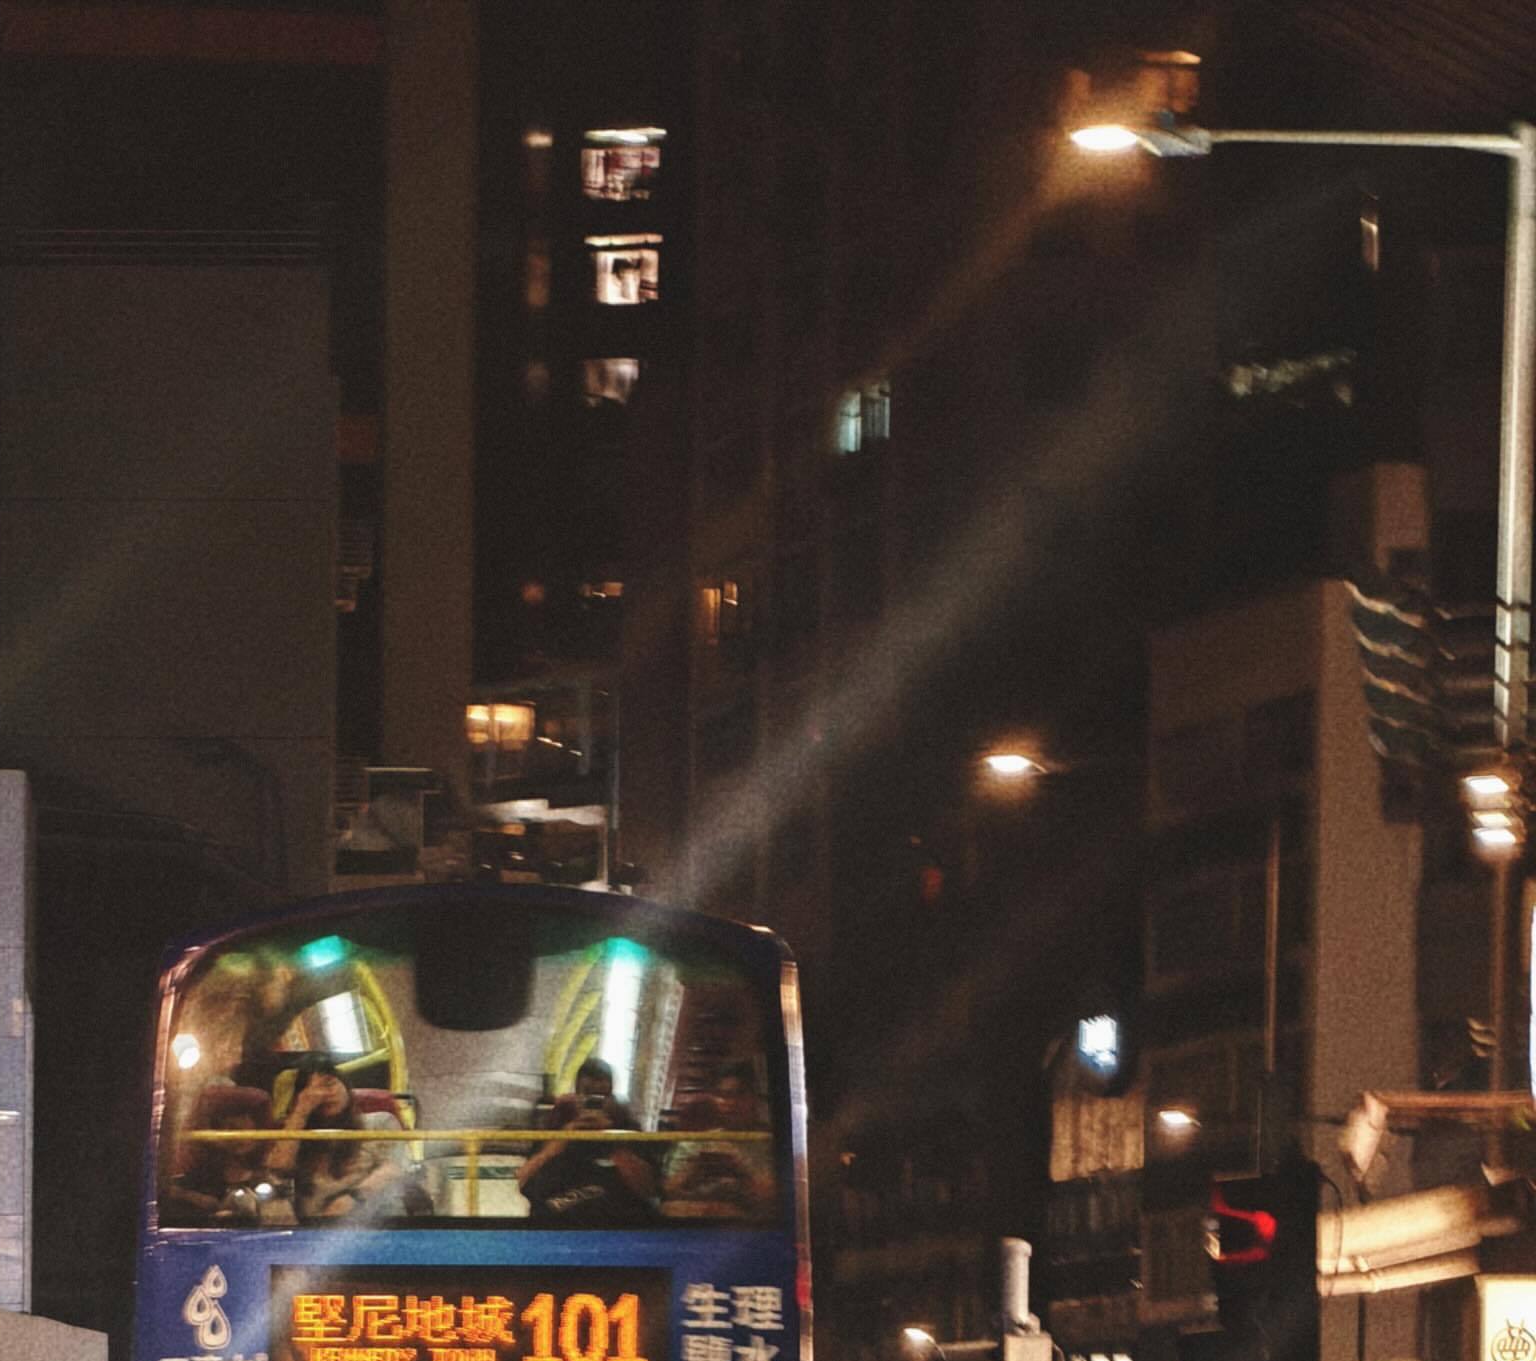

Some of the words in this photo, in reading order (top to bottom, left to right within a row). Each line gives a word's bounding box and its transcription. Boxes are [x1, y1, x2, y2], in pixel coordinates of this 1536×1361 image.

[292, 1295, 516, 1343] 堅尼地城
[680, 1283, 784, 1330] 生理
